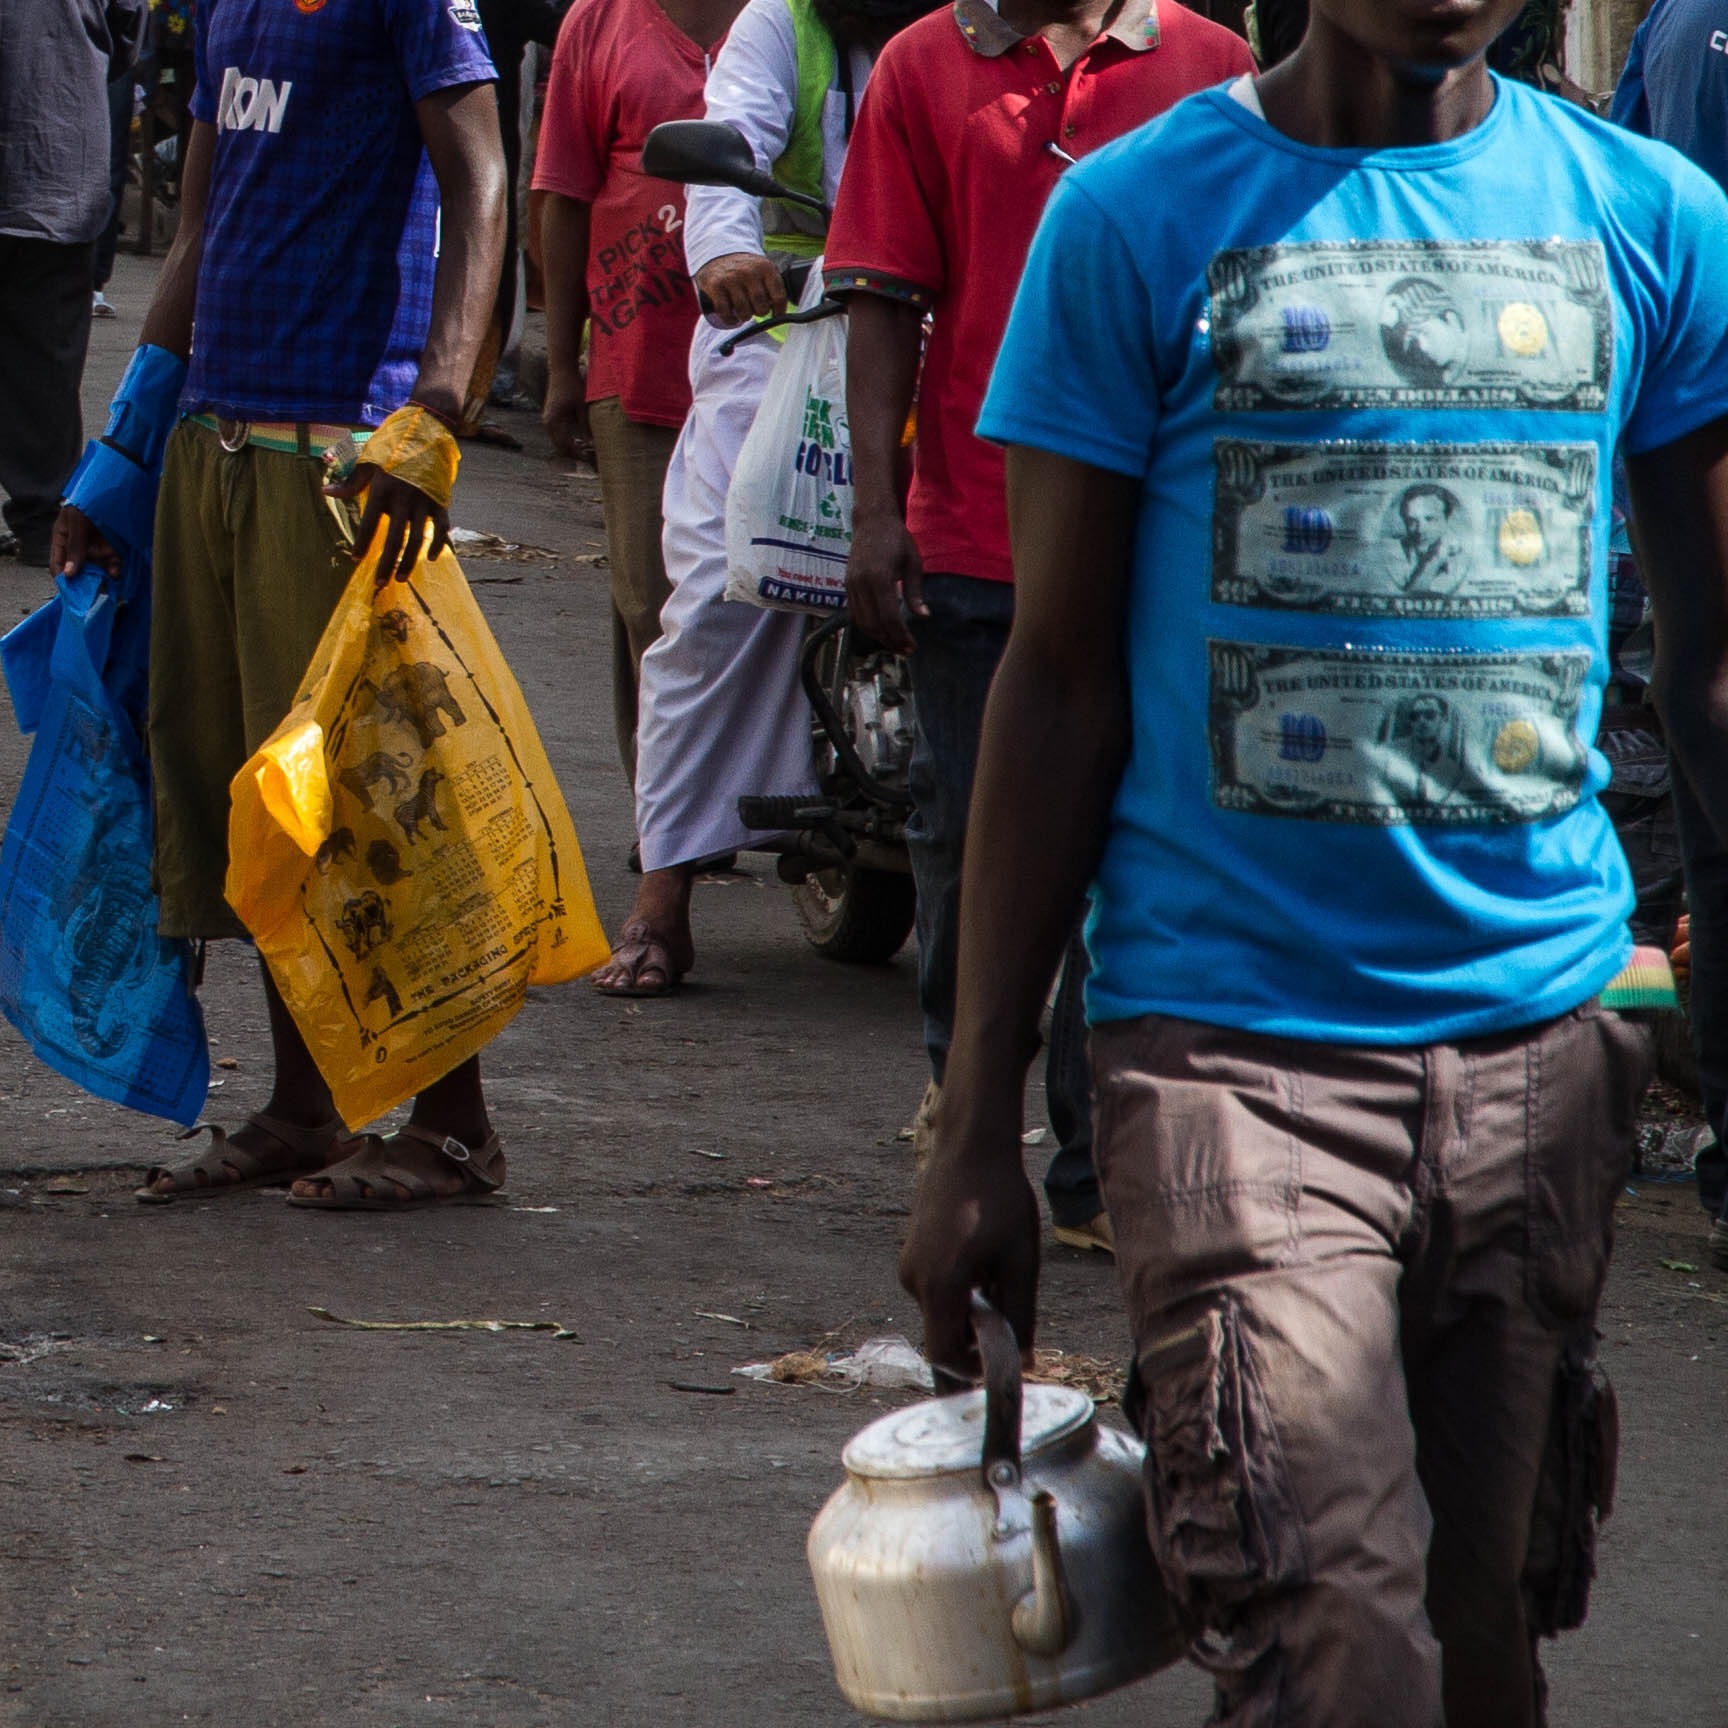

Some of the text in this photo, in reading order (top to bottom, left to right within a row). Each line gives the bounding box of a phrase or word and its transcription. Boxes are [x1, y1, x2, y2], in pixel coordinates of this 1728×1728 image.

[597, 204, 683, 274] PICK 2
[1260, 272, 1299, 290] THE
[1304, 261, 1374, 281] UNITED
[1447, 259, 1473, 273] OF
[1476, 262, 1561, 286] AMERICA
[1394, 387, 1518, 403] DOLLARS
[1269, 473, 1308, 488] THE
[1313, 466, 1387, 483] UNITED
[1465, 465, 1487, 480] OF
[1490, 467, 1560, 493] AMERICA
[1281, 506, 1333, 554] 10
[1394, 597, 1517, 613] DOLLARS
[1263, 677, 1303, 694] THE
[1306, 673, 1383, 690] UNITED
[1384, 674, 1458, 690] STATES
[1461, 675, 1486, 691] OF
[1277, 711, 1327, 763] 10
[440, 943, 508, 987] PACKAGING
